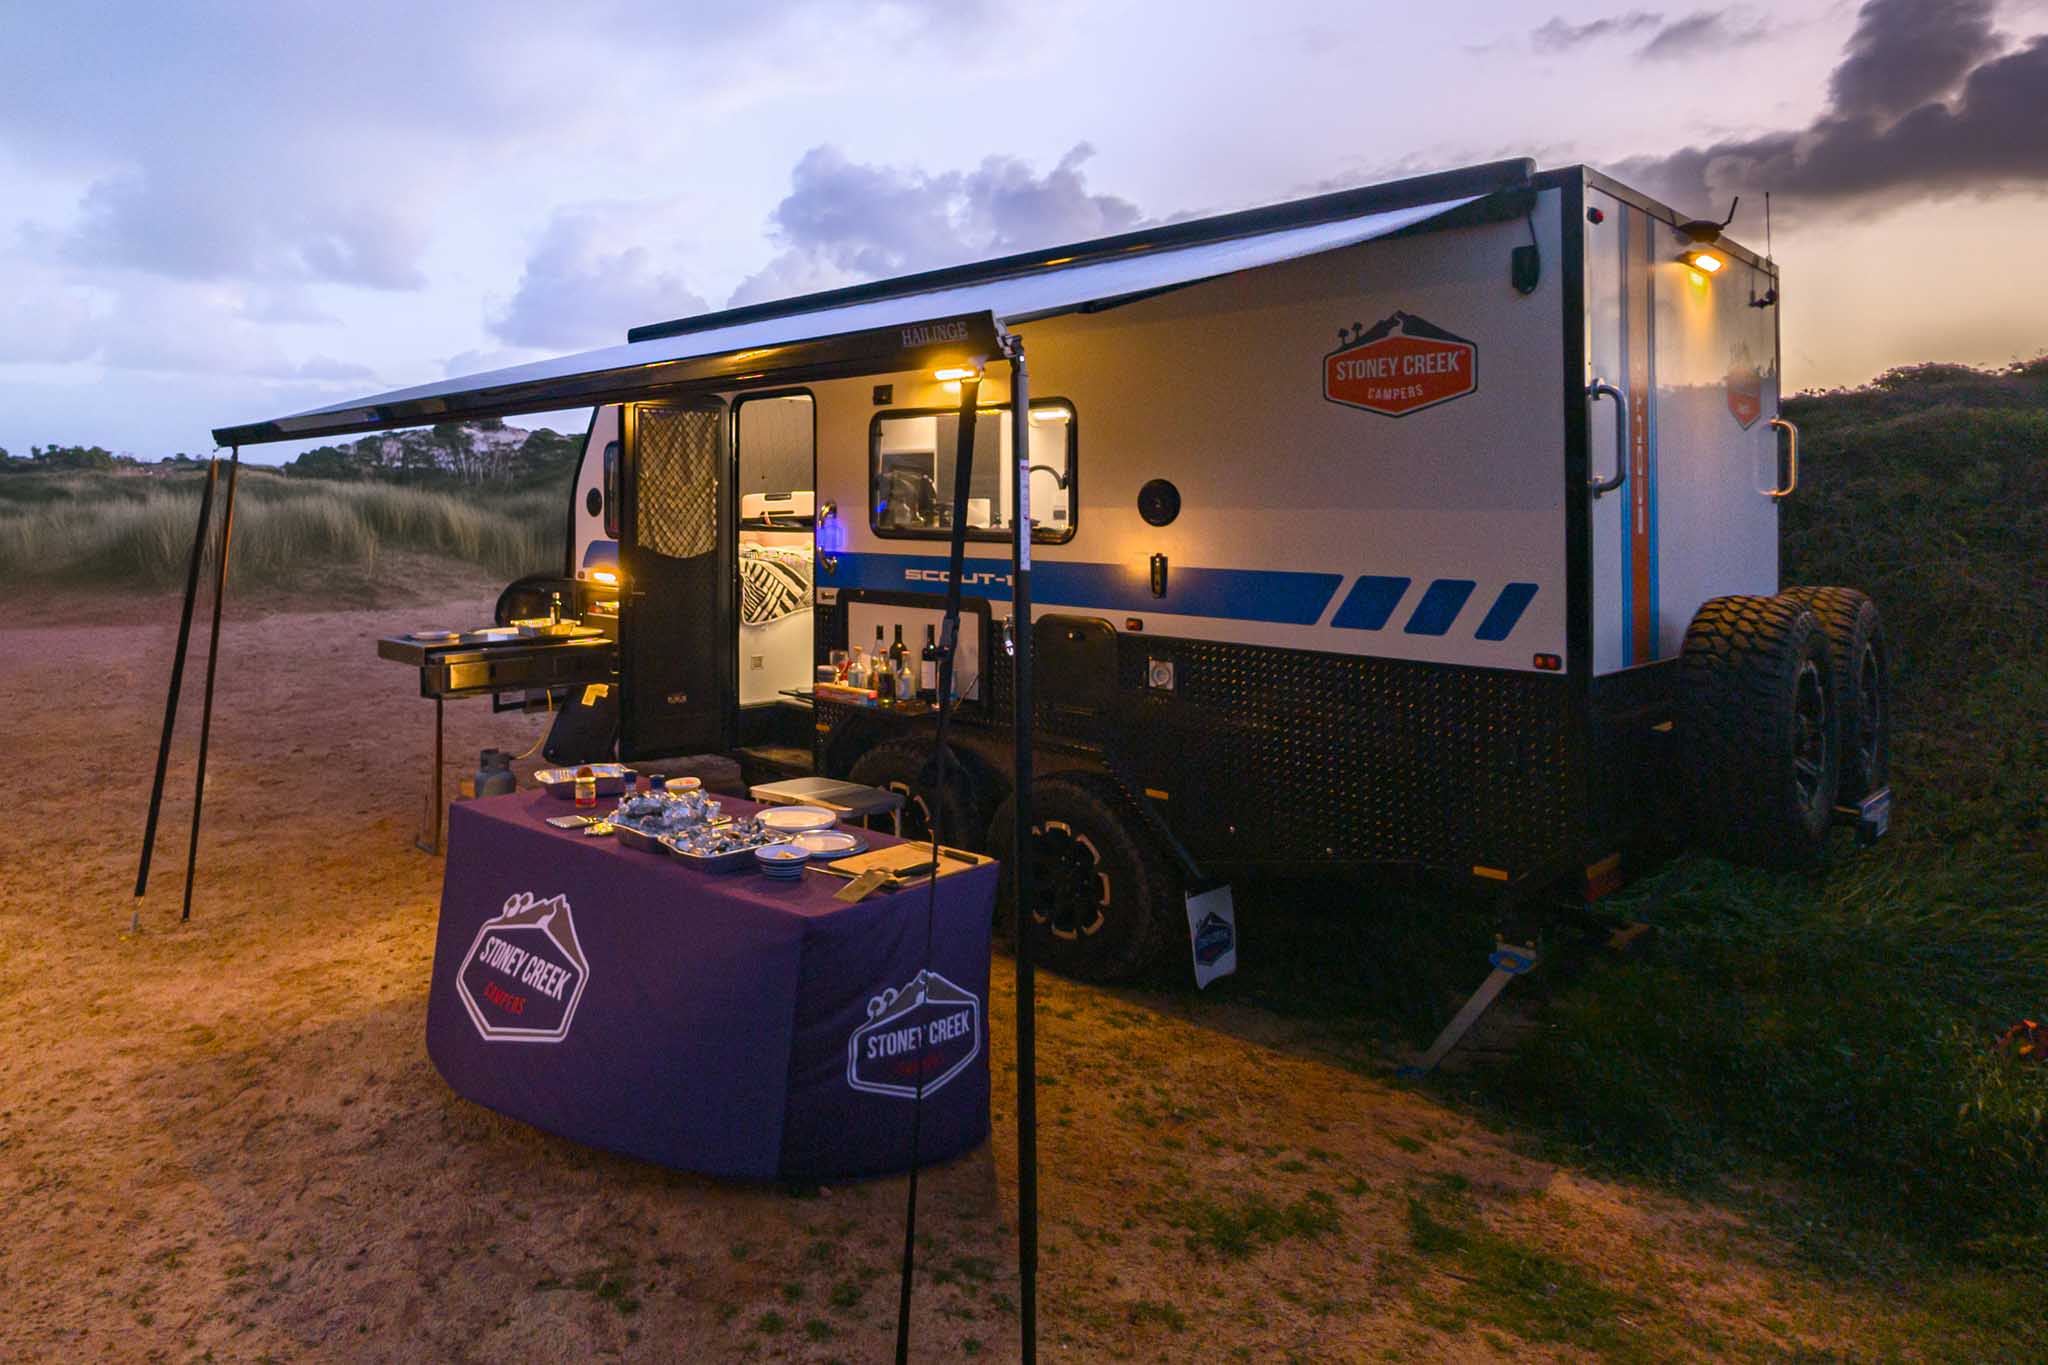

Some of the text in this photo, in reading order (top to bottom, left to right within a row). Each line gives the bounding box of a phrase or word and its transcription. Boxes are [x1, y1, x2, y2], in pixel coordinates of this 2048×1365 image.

[1336, 350, 1460, 381] STONEY CREEK
[1367, 384, 1424, 400] CAMPERS
[479, 935, 573, 1001] STONEY CREEK
[929, 1009, 971, 1045] CREEK
